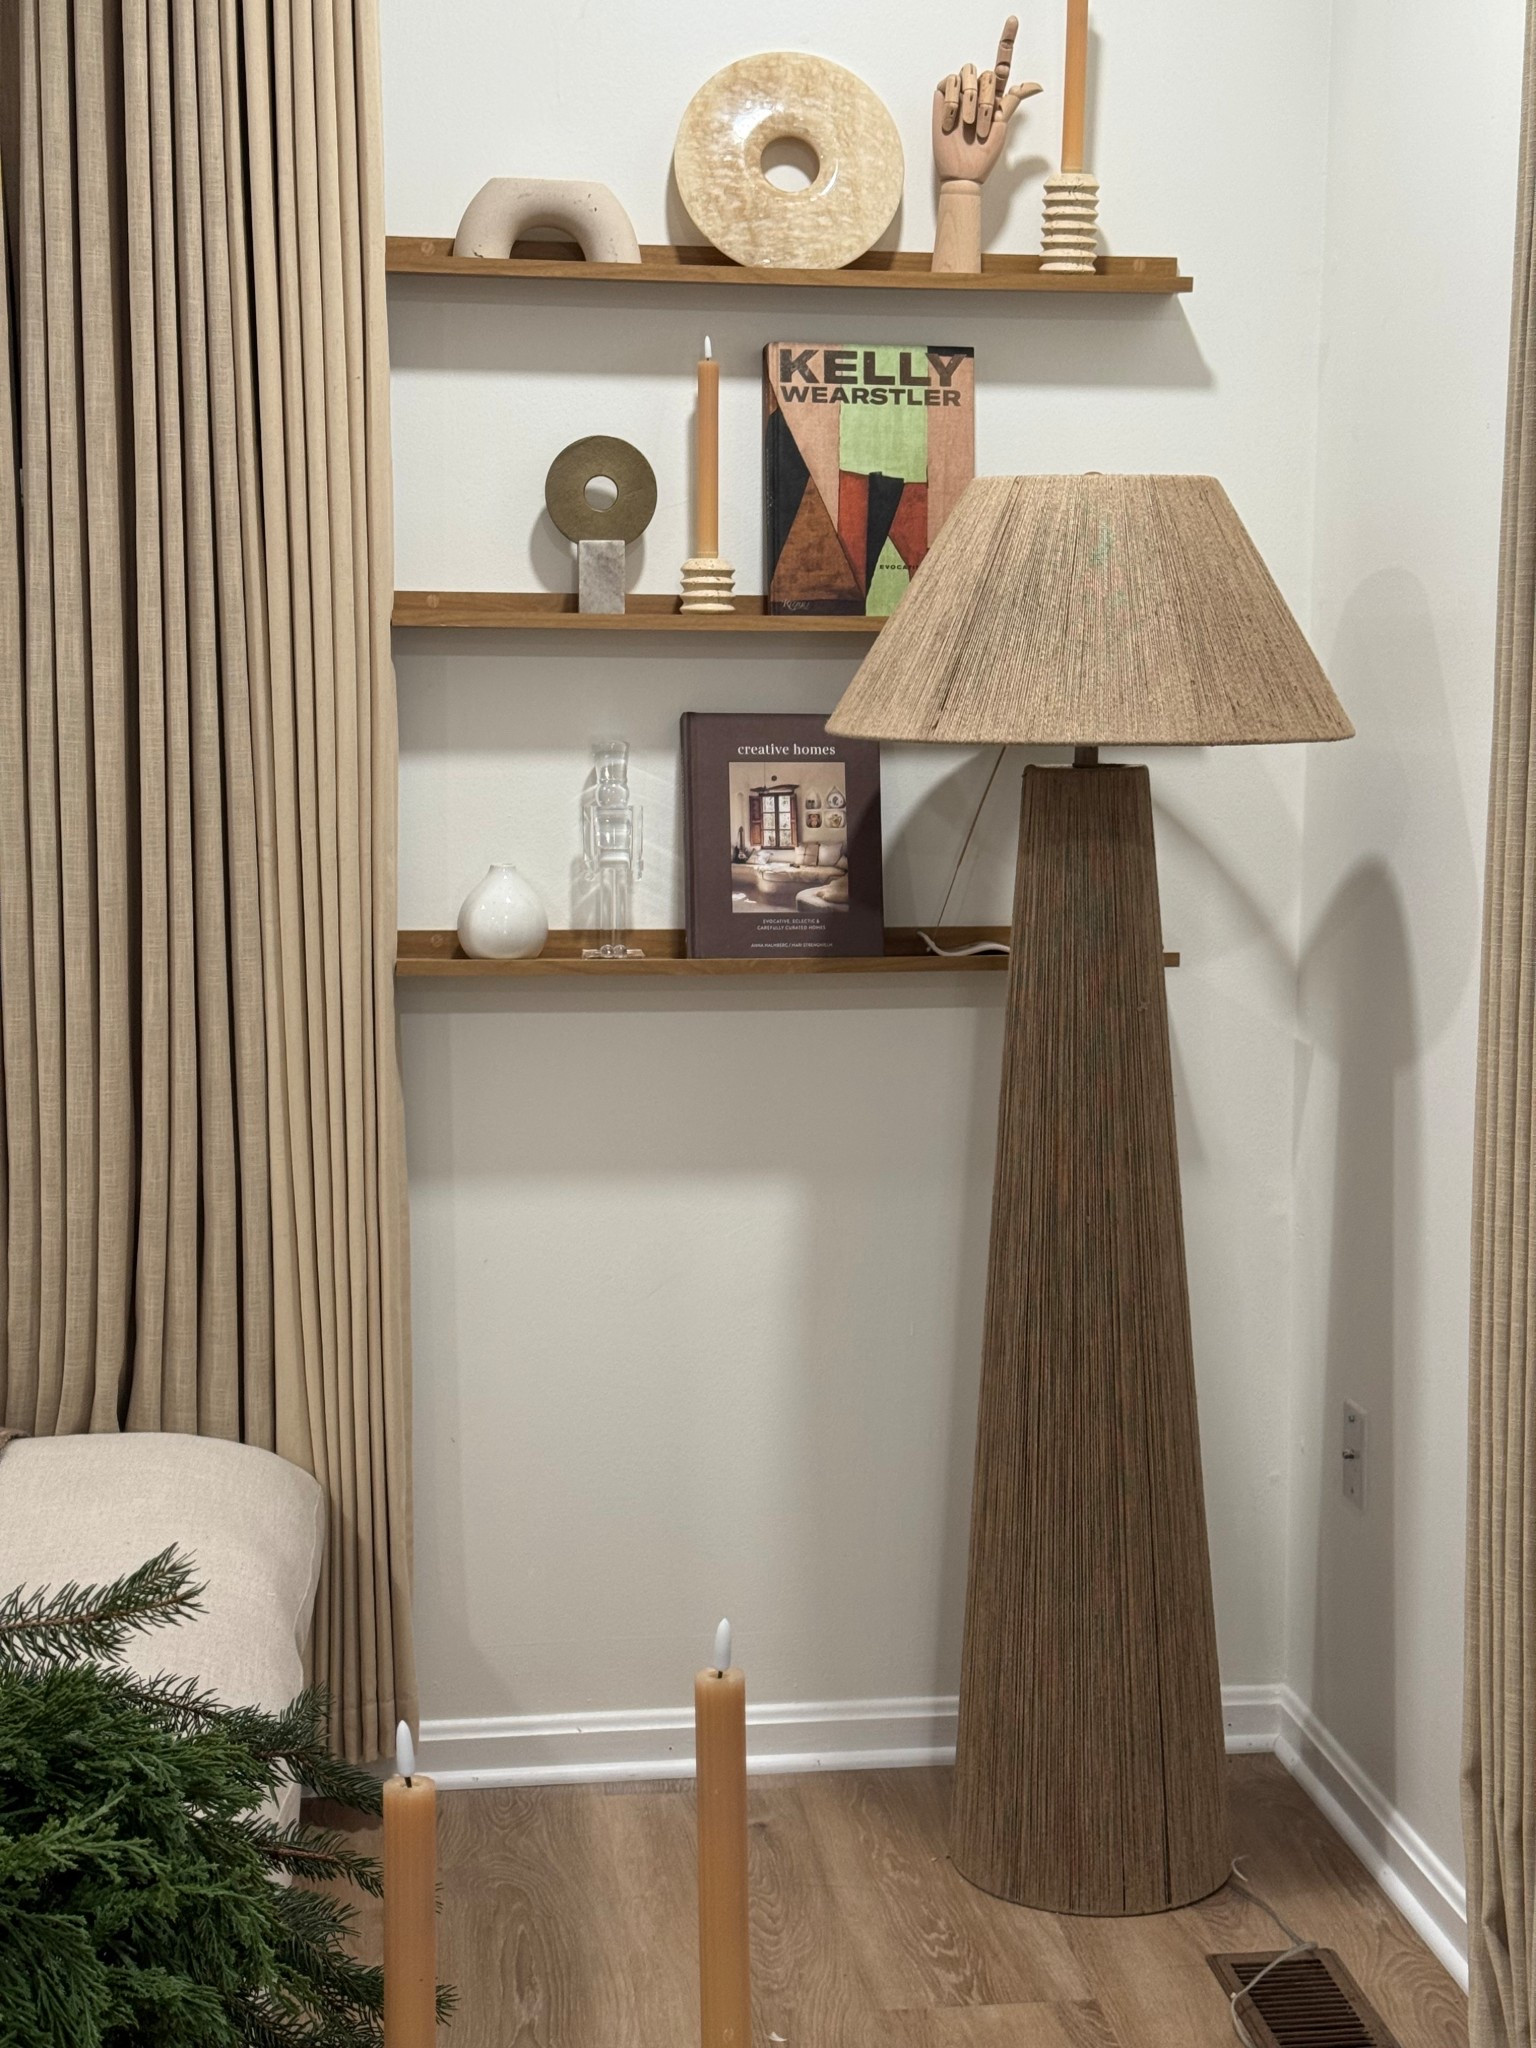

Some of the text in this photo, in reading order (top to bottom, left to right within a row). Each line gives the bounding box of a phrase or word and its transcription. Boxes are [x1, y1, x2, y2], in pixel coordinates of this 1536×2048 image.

[779, 349, 967, 387] KELLY
[780, 386, 961, 406] WEARSTLER
[737, 743, 836, 755] creative homes
